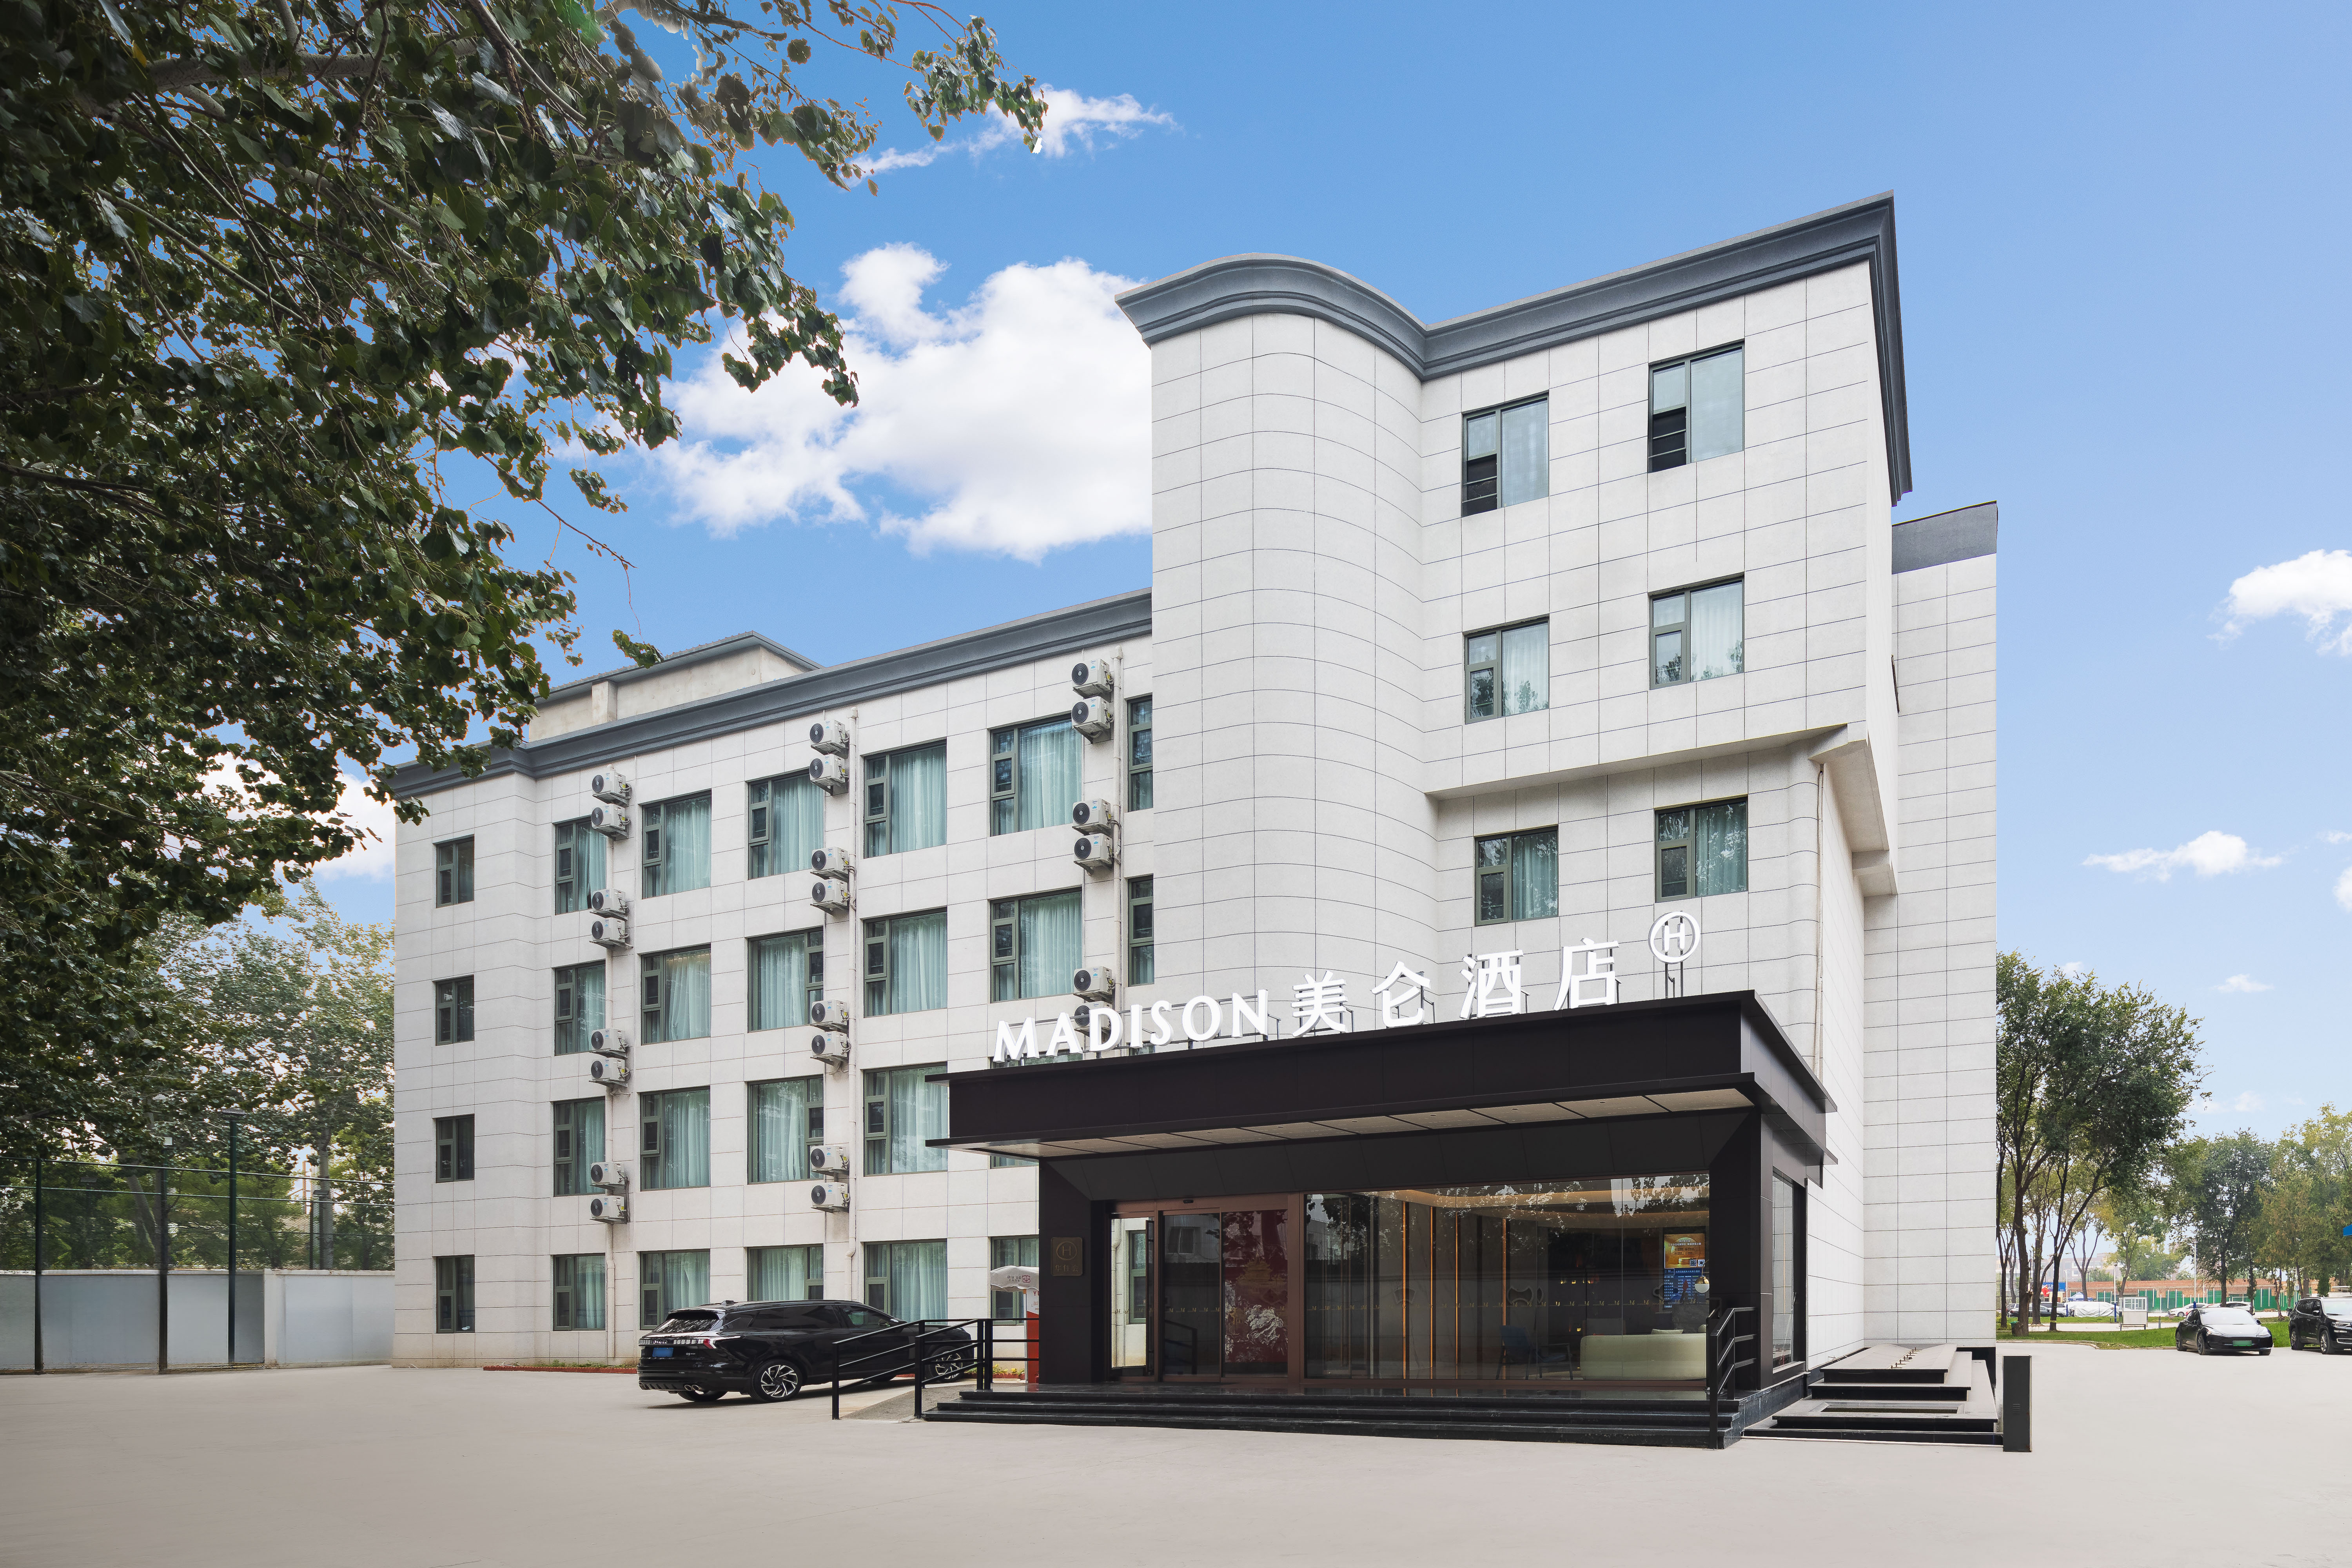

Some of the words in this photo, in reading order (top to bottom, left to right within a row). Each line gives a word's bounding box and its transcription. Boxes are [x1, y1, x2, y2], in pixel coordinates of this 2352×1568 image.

[993, 989, 1269, 1063] MADISON
[1291, 938, 1619, 1037] 美仑酒店
